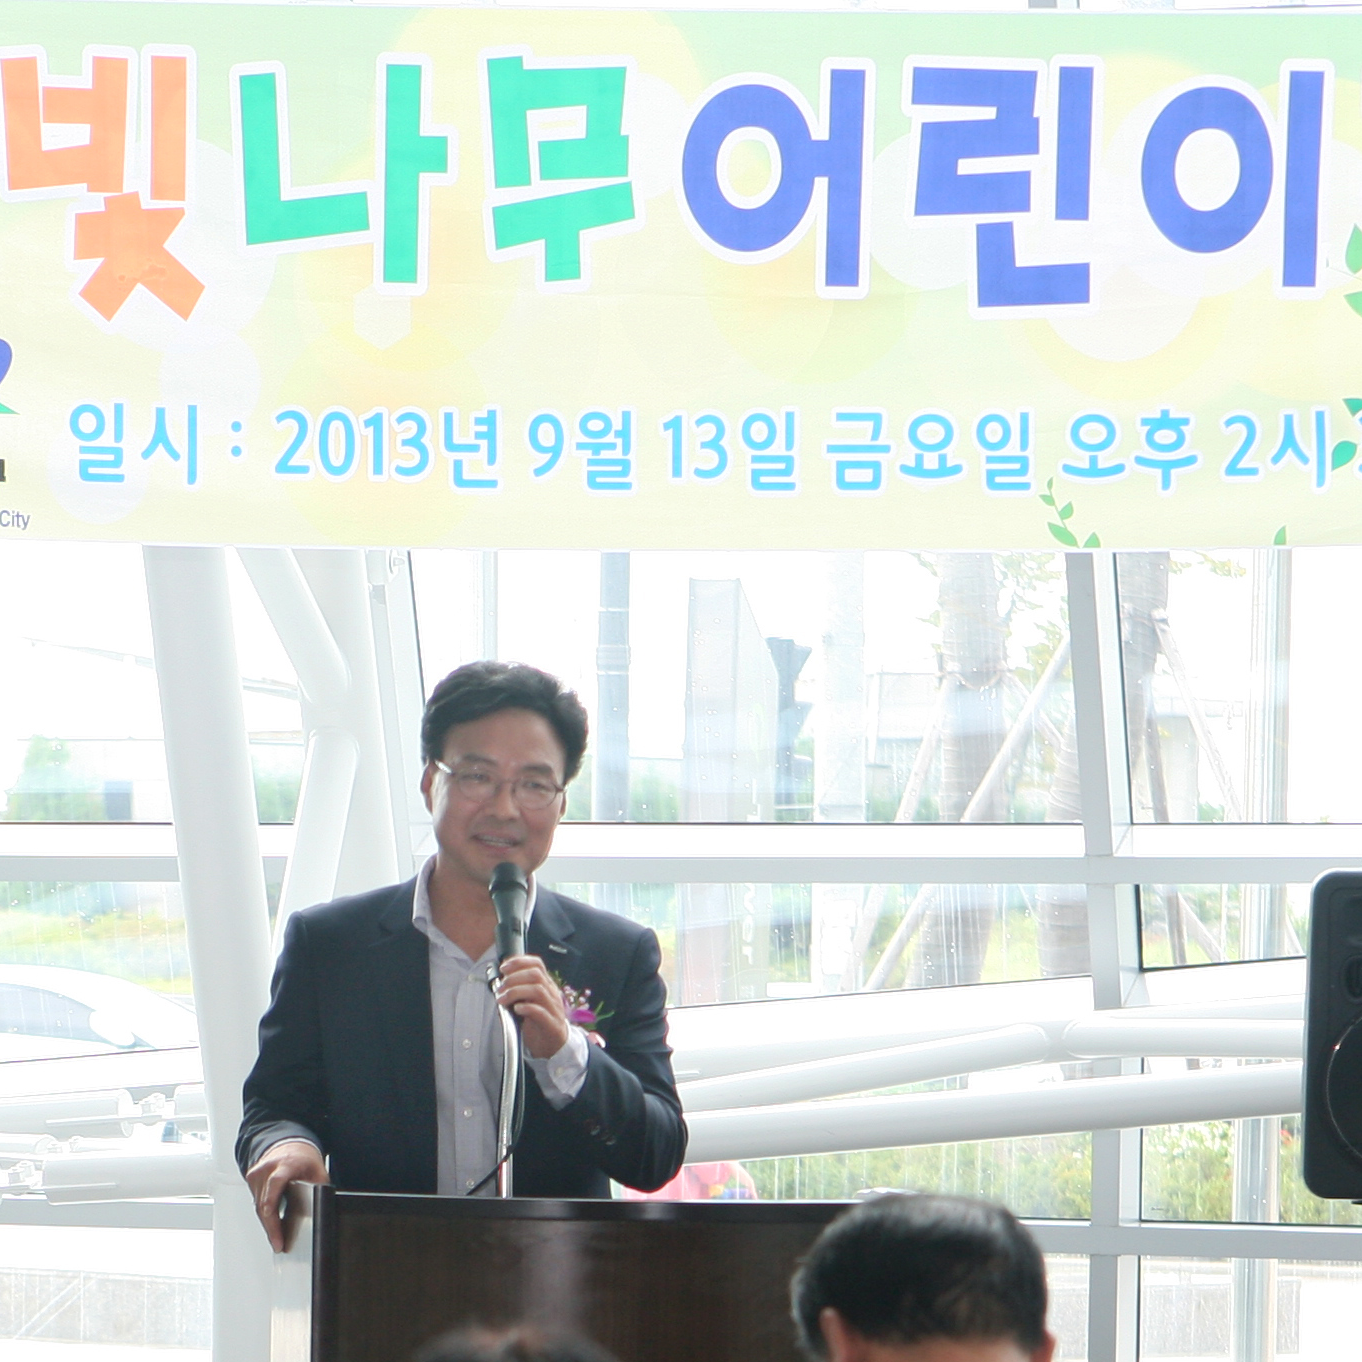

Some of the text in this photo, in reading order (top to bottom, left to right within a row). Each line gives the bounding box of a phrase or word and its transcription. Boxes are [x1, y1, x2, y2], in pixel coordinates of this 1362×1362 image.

[69, 402, 197, 485] 일시
[275, 408, 499, 489] 2013년
[528, 410, 633, 491] 9월
[662, 410, 797, 491] 13일
[826, 411, 1032, 491] 금요일
[1062, 408, 1198, 491] 오후
[1223, 410, 1325, 488] 2시
